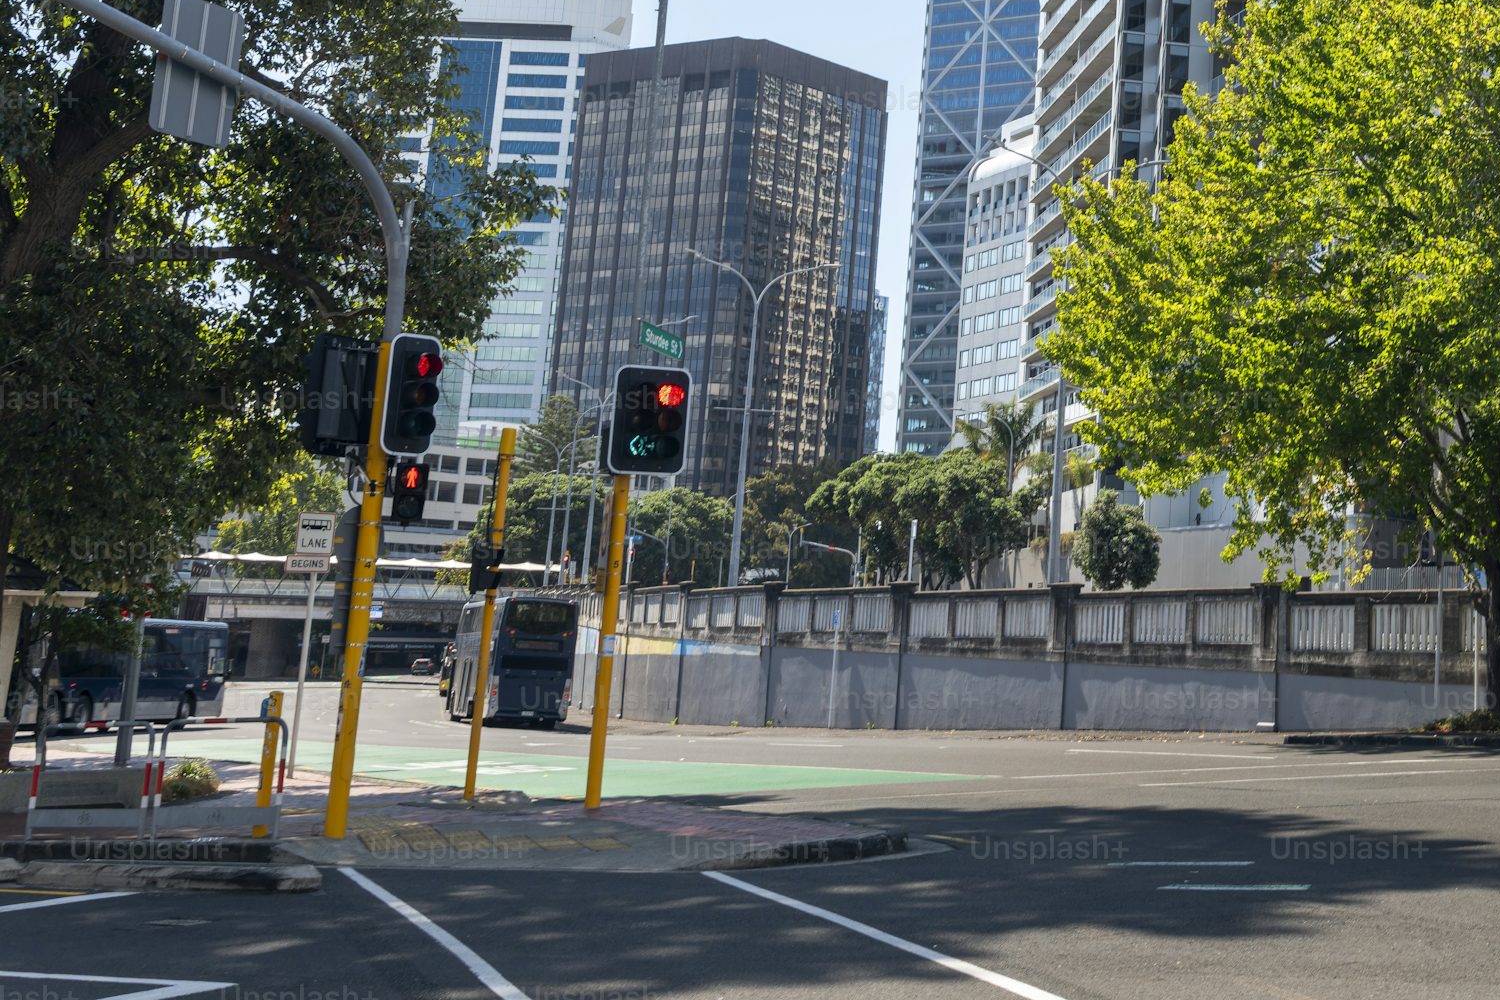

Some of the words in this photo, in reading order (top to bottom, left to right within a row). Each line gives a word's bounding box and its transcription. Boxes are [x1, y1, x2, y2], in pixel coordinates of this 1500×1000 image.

[645, 328, 669, 351] Sturdee
[670, 339, 678, 355] St
[301, 538, 328, 548] LANE
[291, 559, 324, 568] BEGINS
[364, 560, 371, 569] 4
[613, 560, 619, 569] 5
